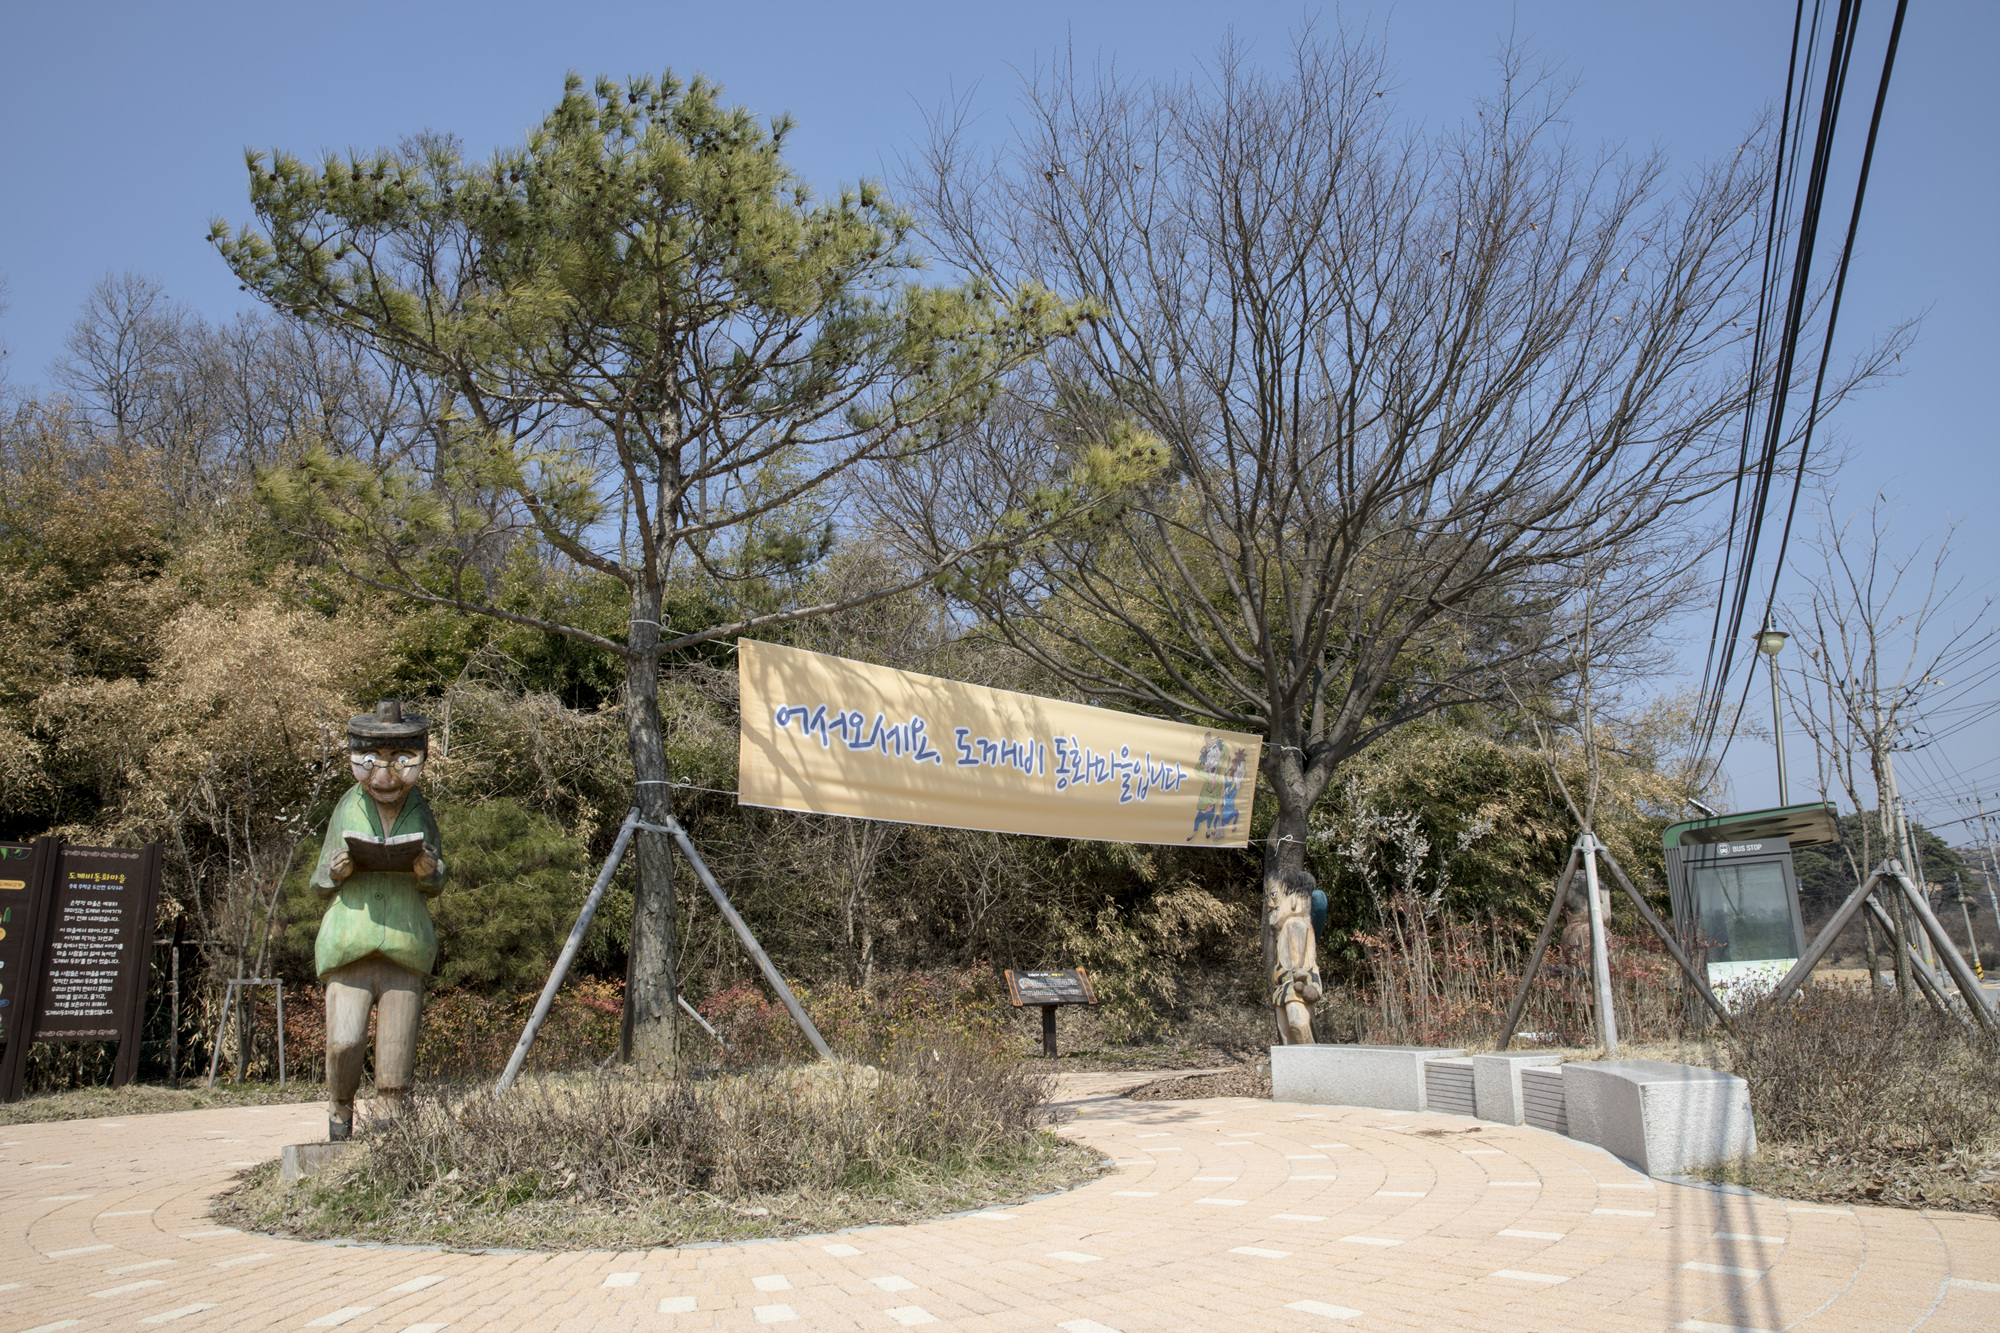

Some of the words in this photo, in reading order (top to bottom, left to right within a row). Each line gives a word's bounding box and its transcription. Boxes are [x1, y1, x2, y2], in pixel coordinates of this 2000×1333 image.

[956, 726, 1045, 777] 도깨비
[1054, 735, 1188, 805] 동화마을입니다
[68, 872, 126, 883] 도깨비동화마을
